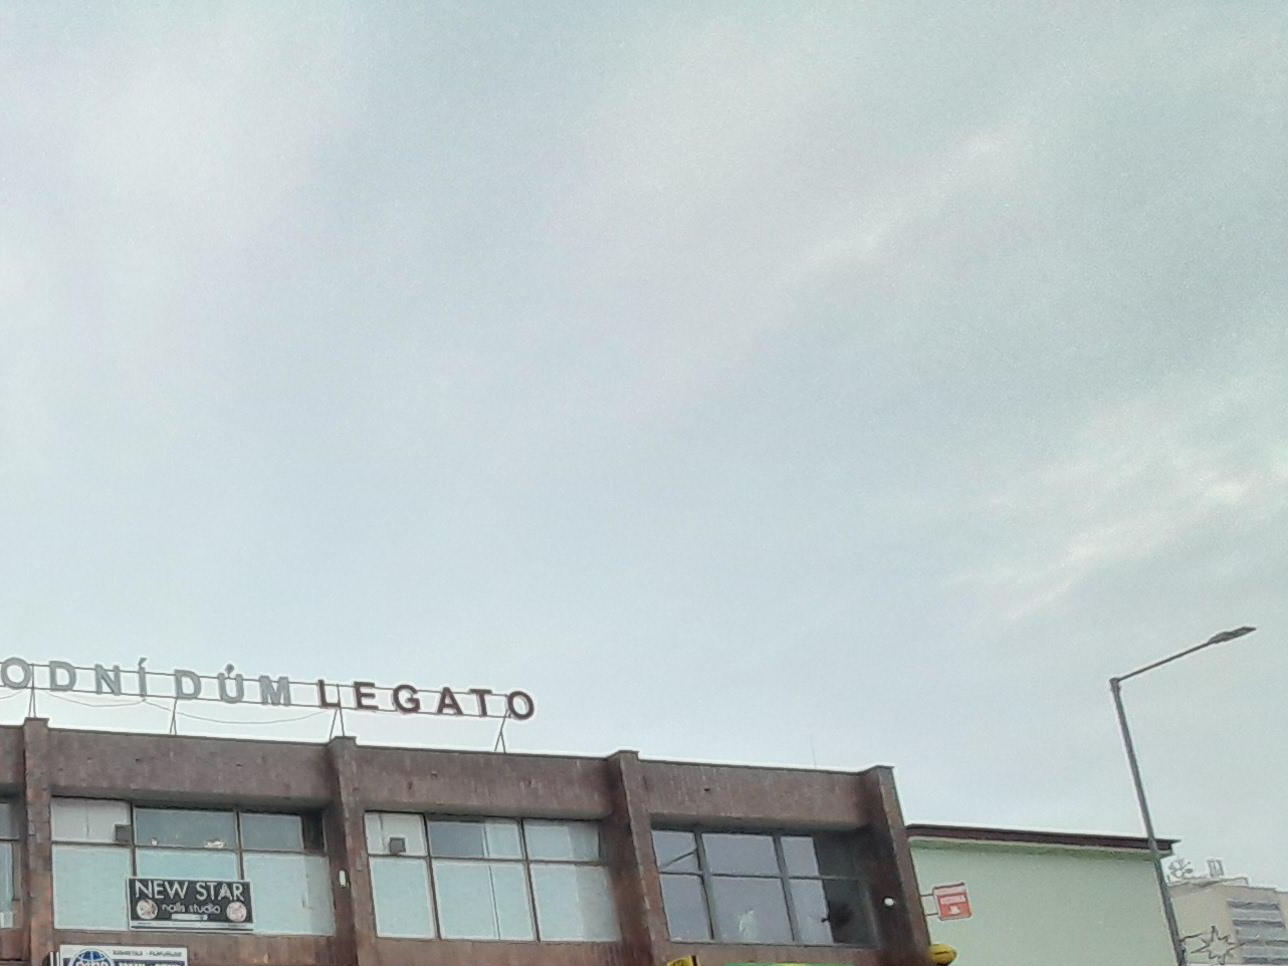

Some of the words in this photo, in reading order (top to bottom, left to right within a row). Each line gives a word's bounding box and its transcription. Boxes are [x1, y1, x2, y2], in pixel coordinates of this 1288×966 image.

[174, 663, 292, 706] DŮM
[317, 679, 535, 720] LEGATO
[135, 880, 189, 899] NEW
[196, 882, 245, 901] STAR
[189, 903, 221, 914] studio
